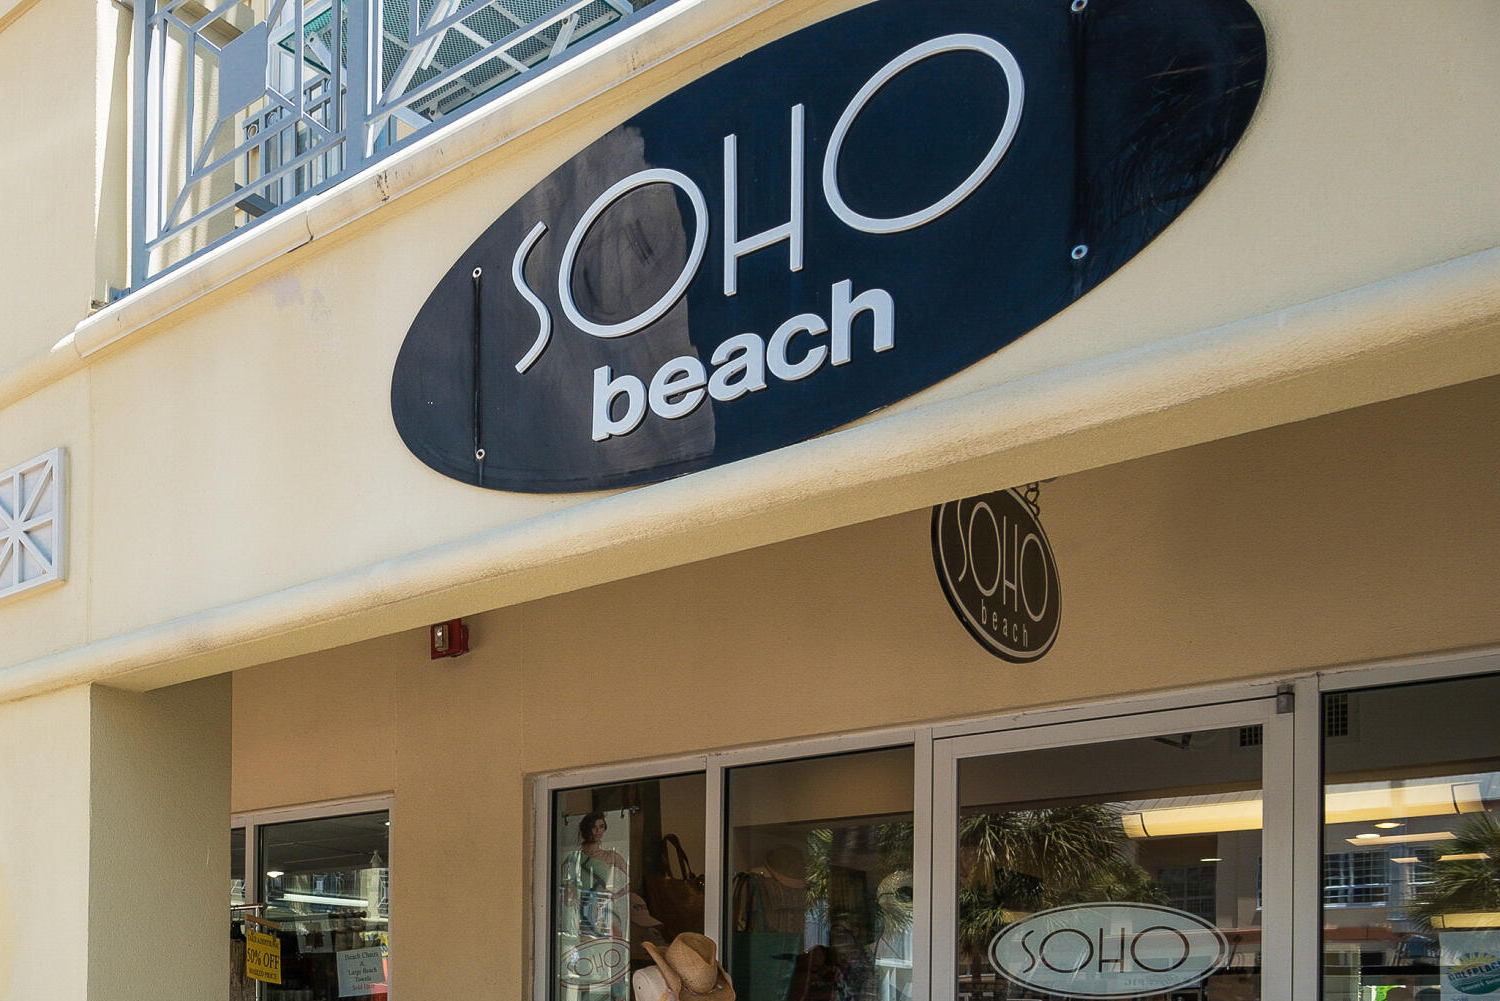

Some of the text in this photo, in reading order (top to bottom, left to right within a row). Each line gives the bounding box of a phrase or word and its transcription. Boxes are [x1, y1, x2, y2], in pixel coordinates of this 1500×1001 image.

[511, 32, 1026, 375] SOHO
[590, 278, 896, 442] beach
[957, 498, 1049, 623] SOHO
[980, 598, 1029, 648] beach
[247, 947, 279, 969] 50% OFF
[1020, 925, 1191, 974] SOHO
